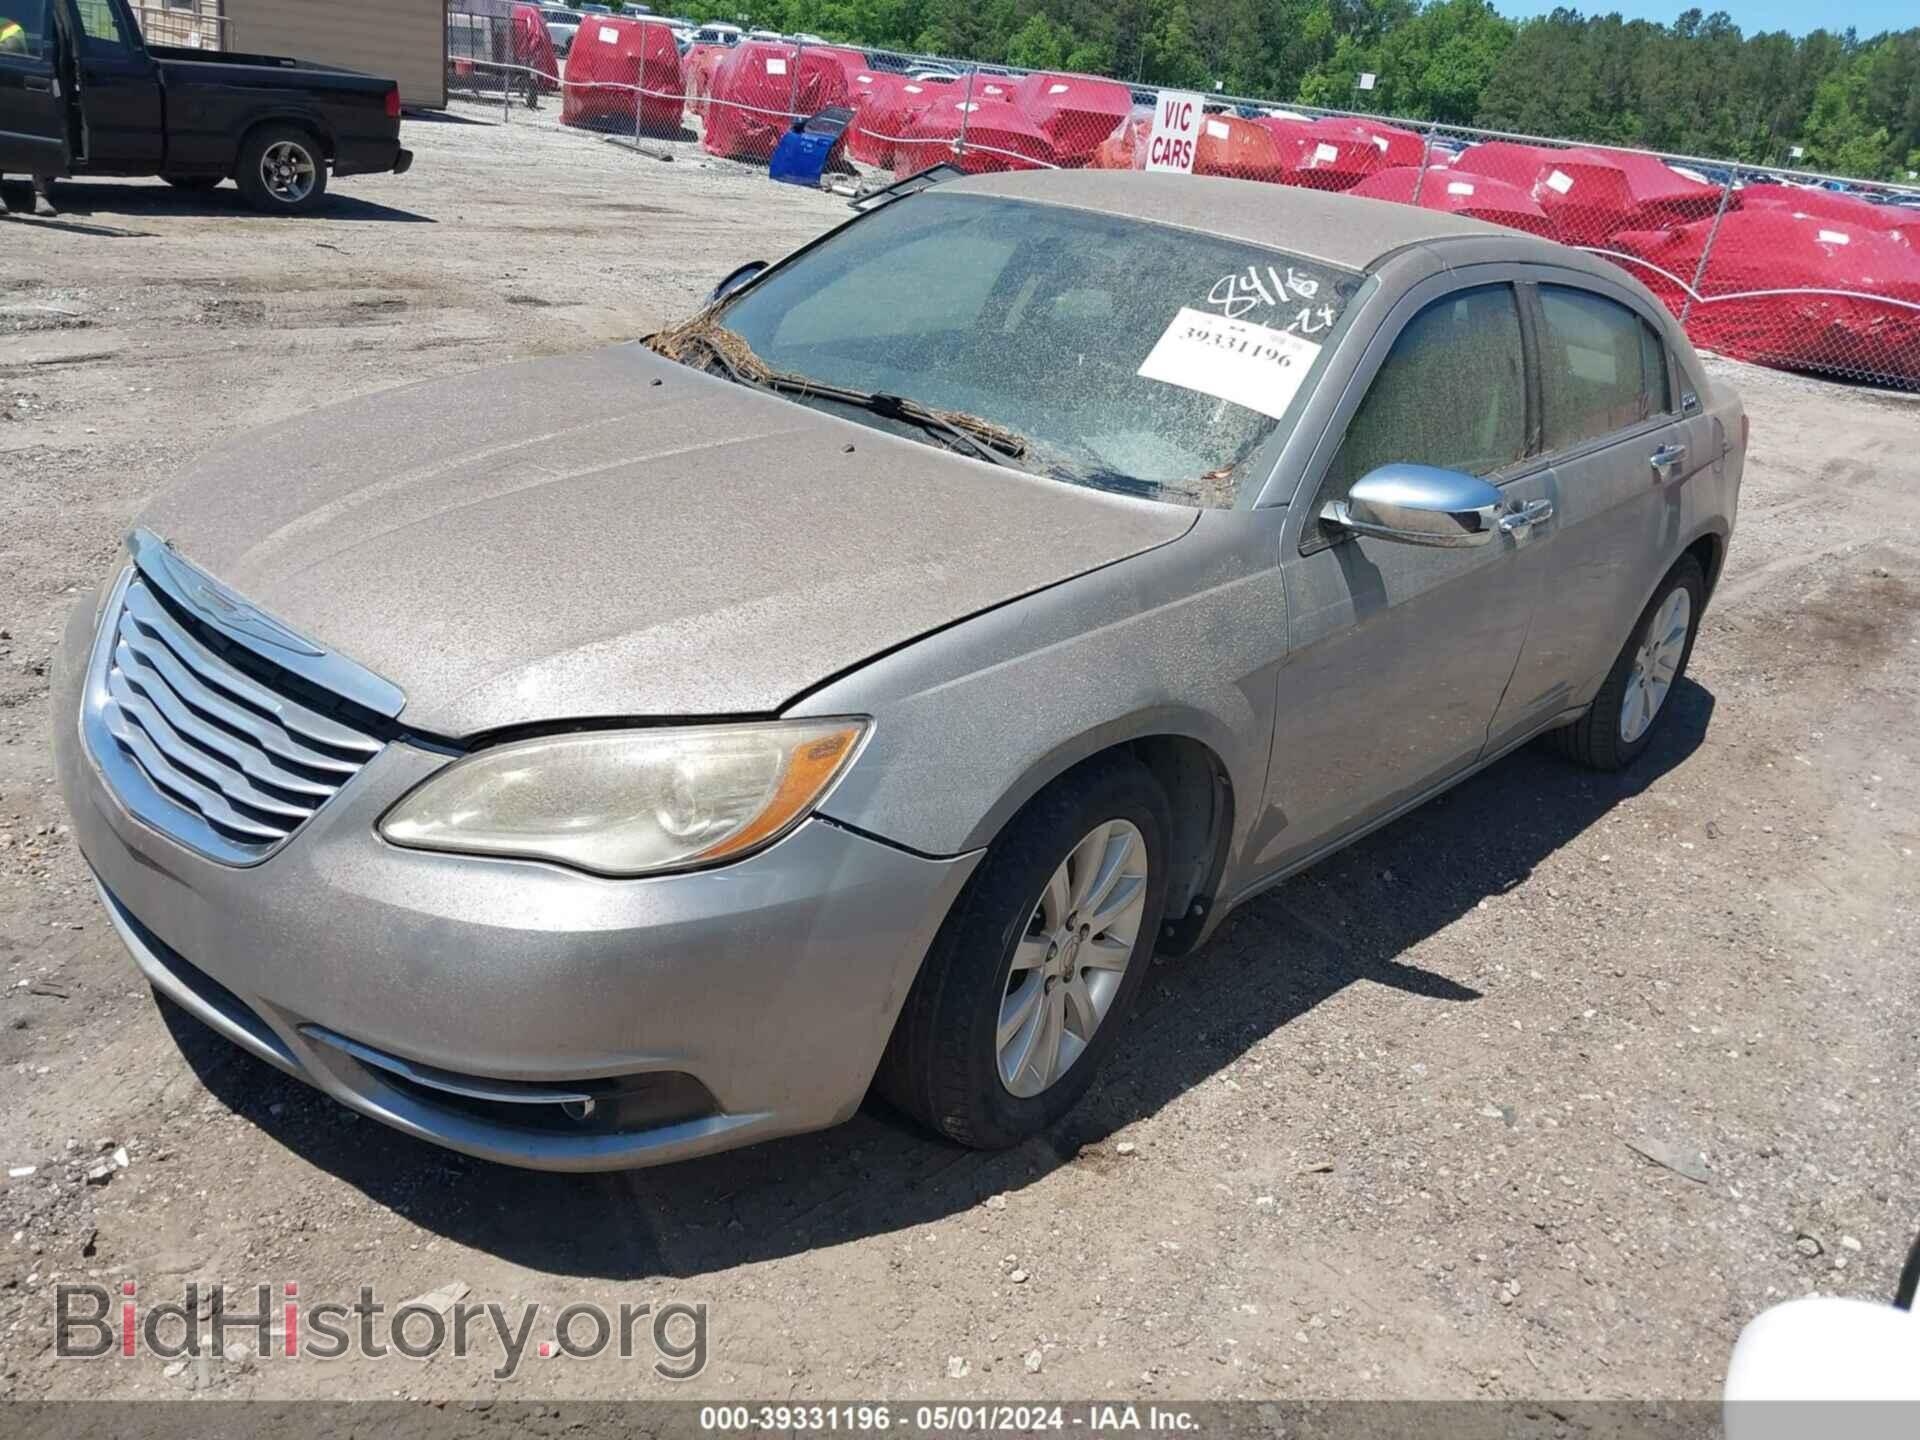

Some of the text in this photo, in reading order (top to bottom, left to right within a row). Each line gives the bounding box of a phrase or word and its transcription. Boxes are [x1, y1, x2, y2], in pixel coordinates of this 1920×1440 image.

[1165, 100, 1193, 131] VIC
[1151, 135, 1193, 169] CARS
[1180, 327, 1291, 368] 39331196
